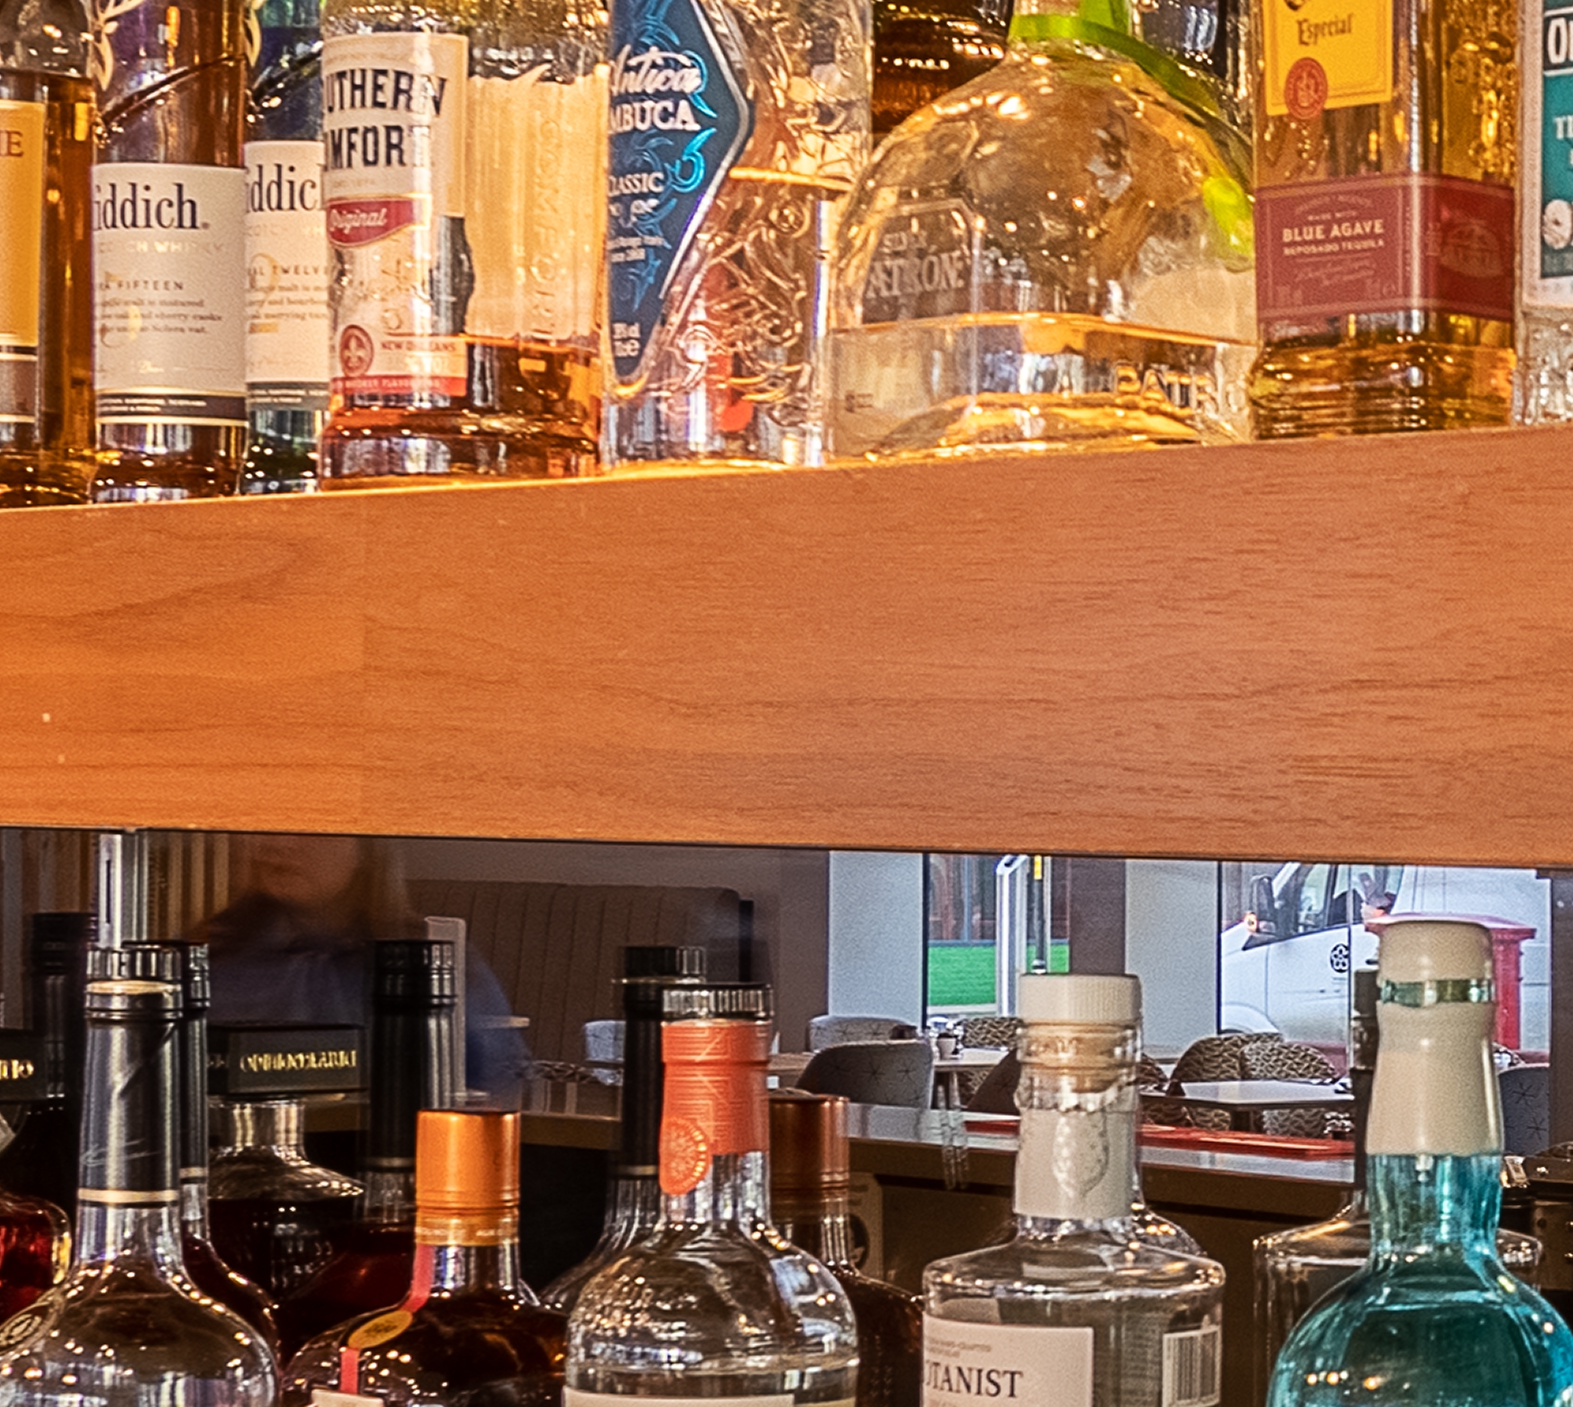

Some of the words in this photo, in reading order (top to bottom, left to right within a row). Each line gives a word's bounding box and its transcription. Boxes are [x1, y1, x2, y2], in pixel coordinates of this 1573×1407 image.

[1296, 11, 1355, 47] Especial
[328, 207, 389, 232] Original
[1281, 223, 1328, 243] BLUE
[1330, 218, 1385, 239] AGAVE
[1283, 243, 1340, 258] REPOSADO
[1342, 237, 1385, 253] TEQUILA
[117, 280, 184, 292] FIFTEEN
